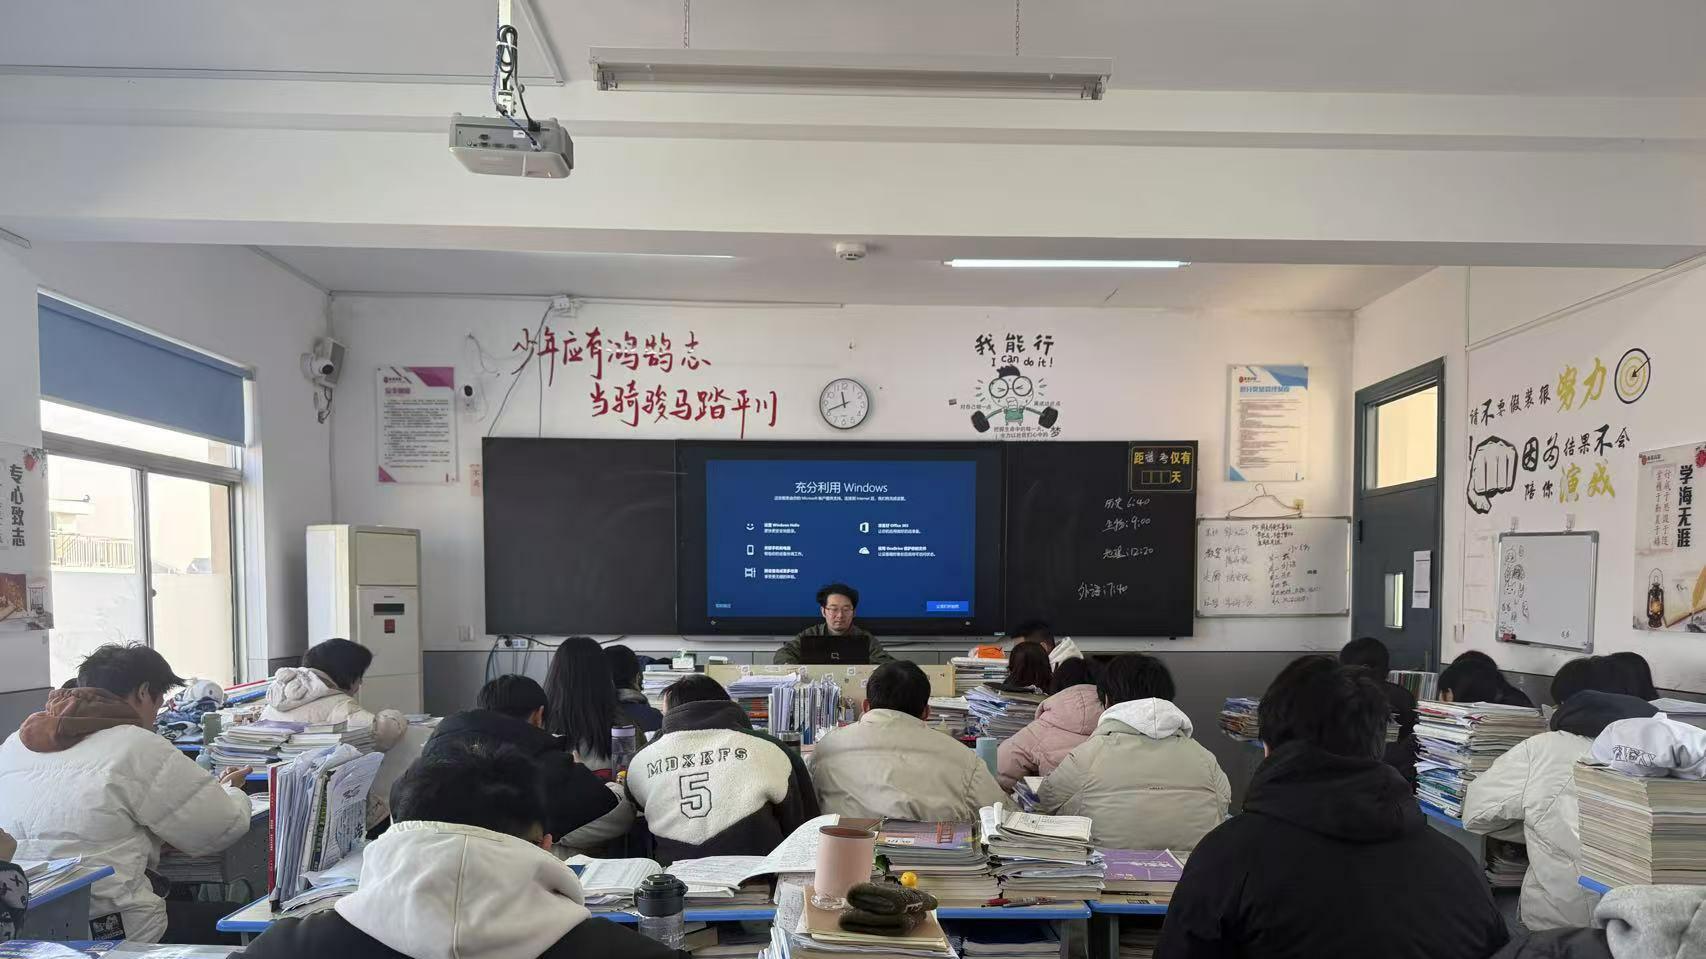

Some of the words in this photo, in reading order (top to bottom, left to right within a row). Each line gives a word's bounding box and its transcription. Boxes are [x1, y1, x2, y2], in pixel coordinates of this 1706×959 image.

[511, 326, 711, 387] 少年应有鸿鹄志
[975, 333, 1054, 355] 我能行
[1001, 355, 1019, 363] can
[1023, 357, 1034, 366] do
[590, 380, 777, 439] 当骑骏马踏平川
[1522, 424, 1630, 471] 因为结果不会
[795, 481, 841, 494] 充分利用
[844, 482, 888, 493] Windows
[1171, 471, 1182, 484] 天
[10, 464, 25, 547] 专心致志
[1677, 464, 1693, 547] 学海无涯
[647, 748, 748, 778] MDXKFS
[679, 772, 712, 819] 5
